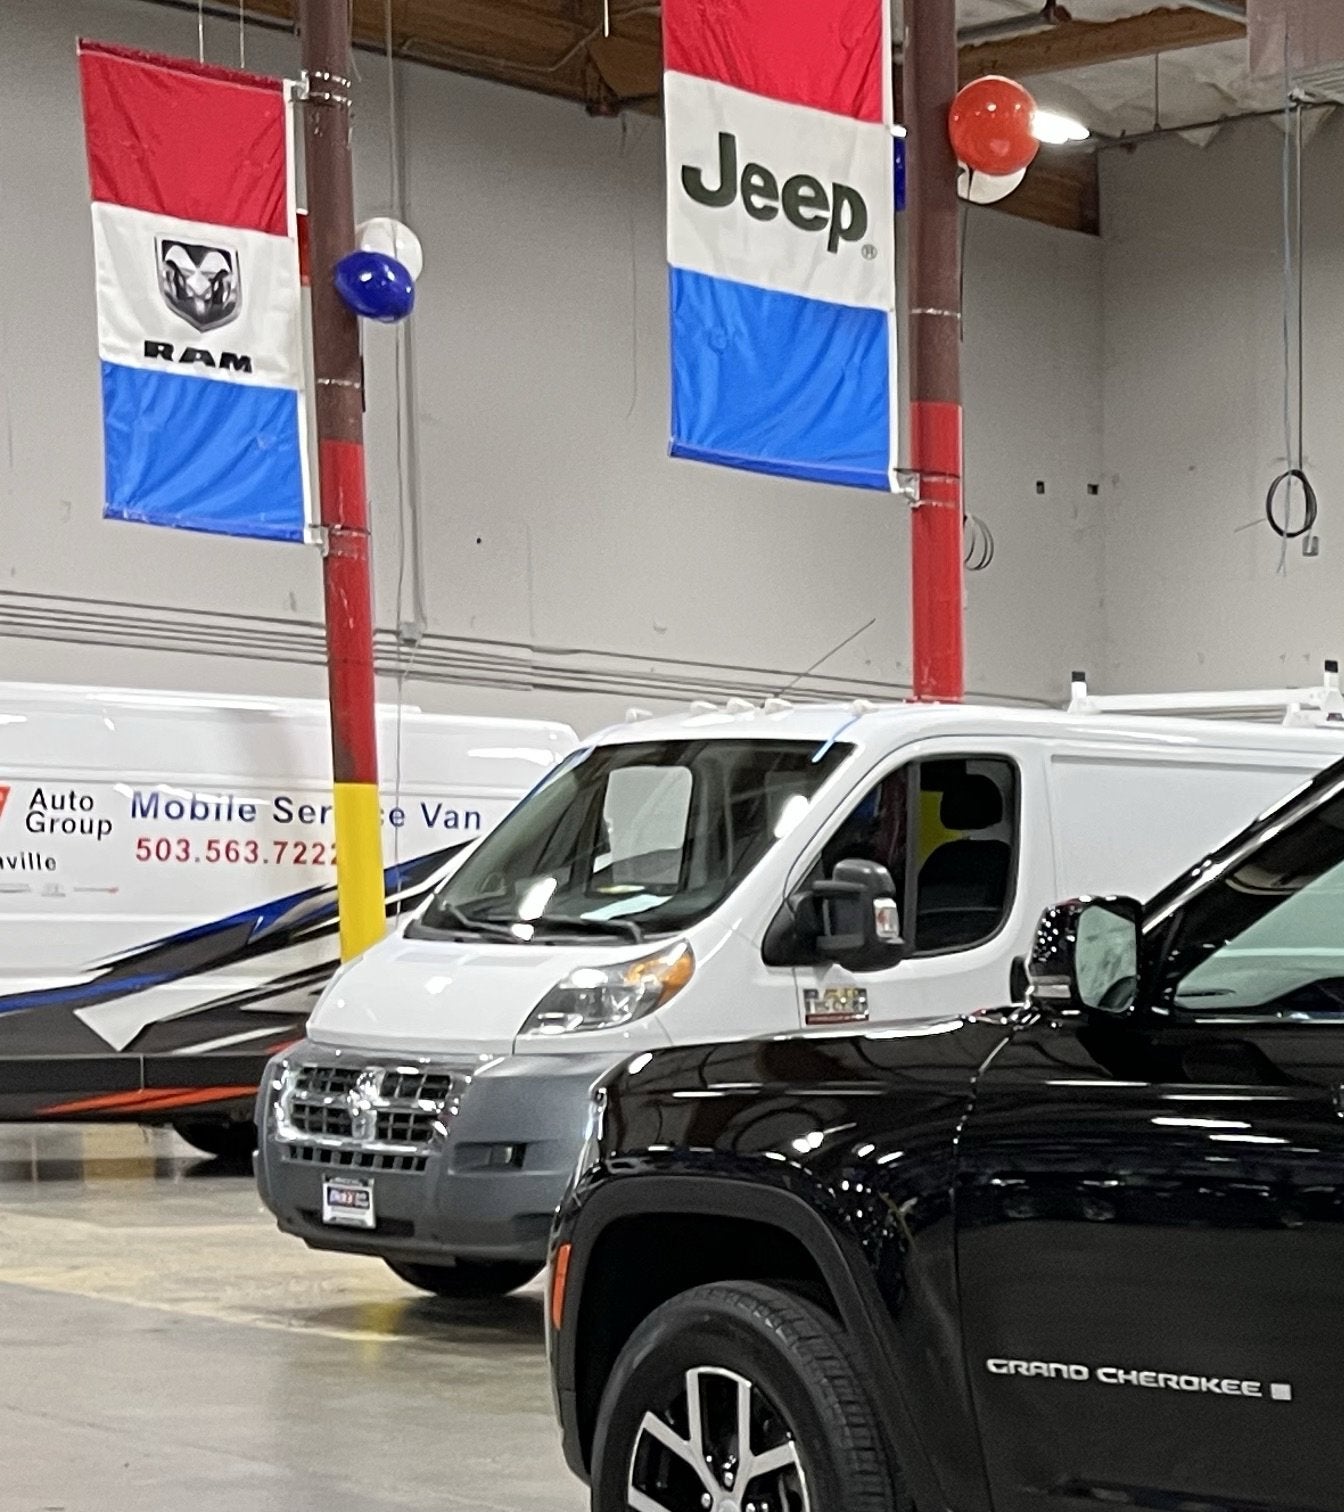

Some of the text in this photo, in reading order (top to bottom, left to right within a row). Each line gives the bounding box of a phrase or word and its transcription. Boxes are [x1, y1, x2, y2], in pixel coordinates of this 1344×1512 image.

[681, 131, 868, 254] Jeep
[144, 340, 253, 373] RAM
[29, 788, 94, 811] Auto
[131, 791, 481, 830] Mobile Sere Van
[26, 811, 112, 841] Group
[986, 1358, 1090, 1381] GRAND
[1096, 1367, 1263, 1398] CHEROKEE
